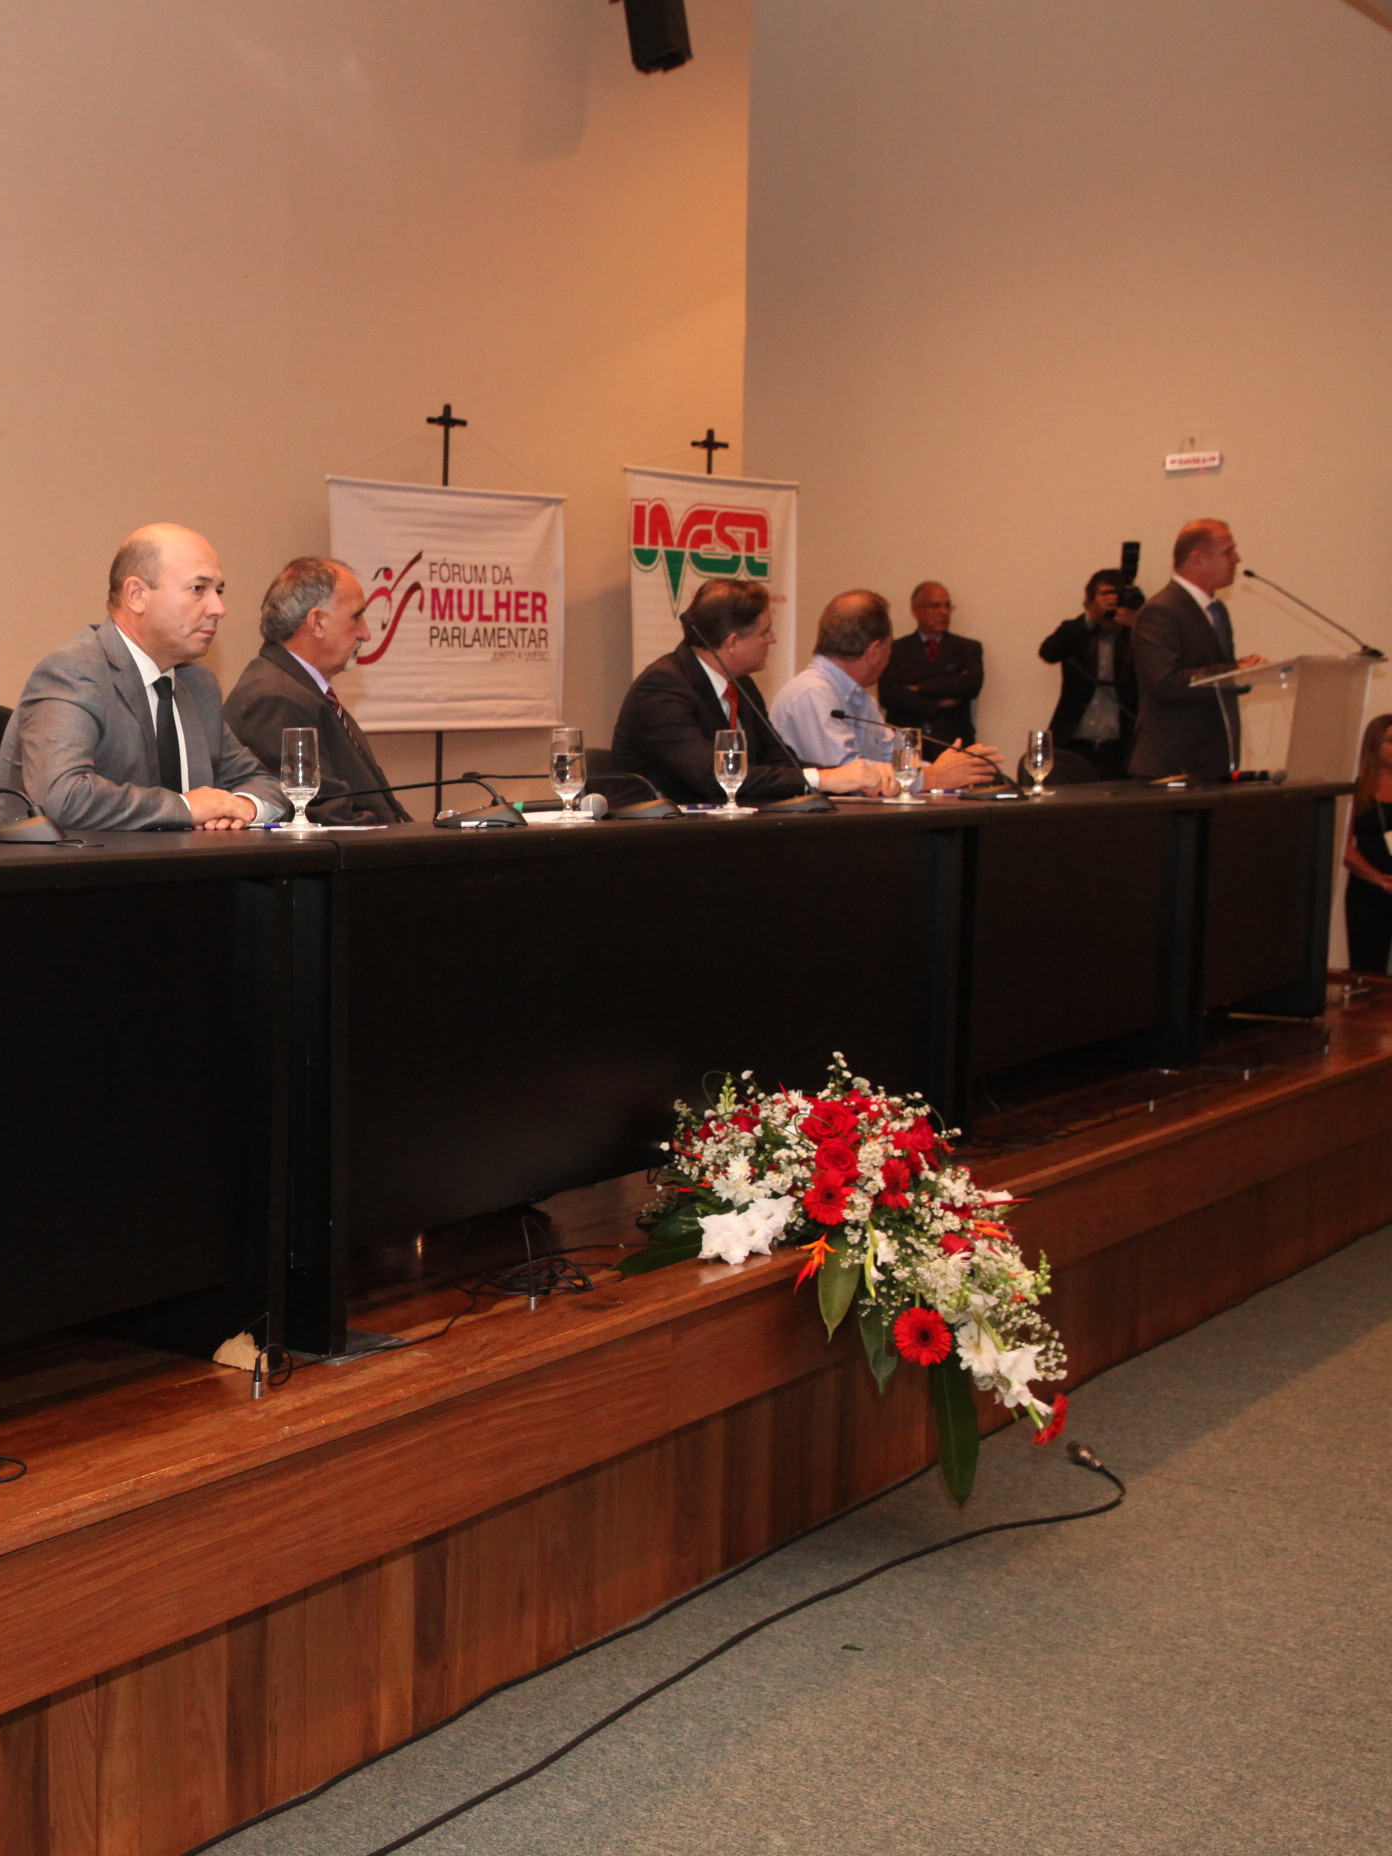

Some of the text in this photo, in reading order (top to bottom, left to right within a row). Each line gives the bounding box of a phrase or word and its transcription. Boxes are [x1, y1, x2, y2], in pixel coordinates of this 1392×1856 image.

[429, 557, 513, 585] FÓRUM DA
[431, 587, 547, 623] MULHER
[429, 625, 548, 649] PARLAMENTAR
